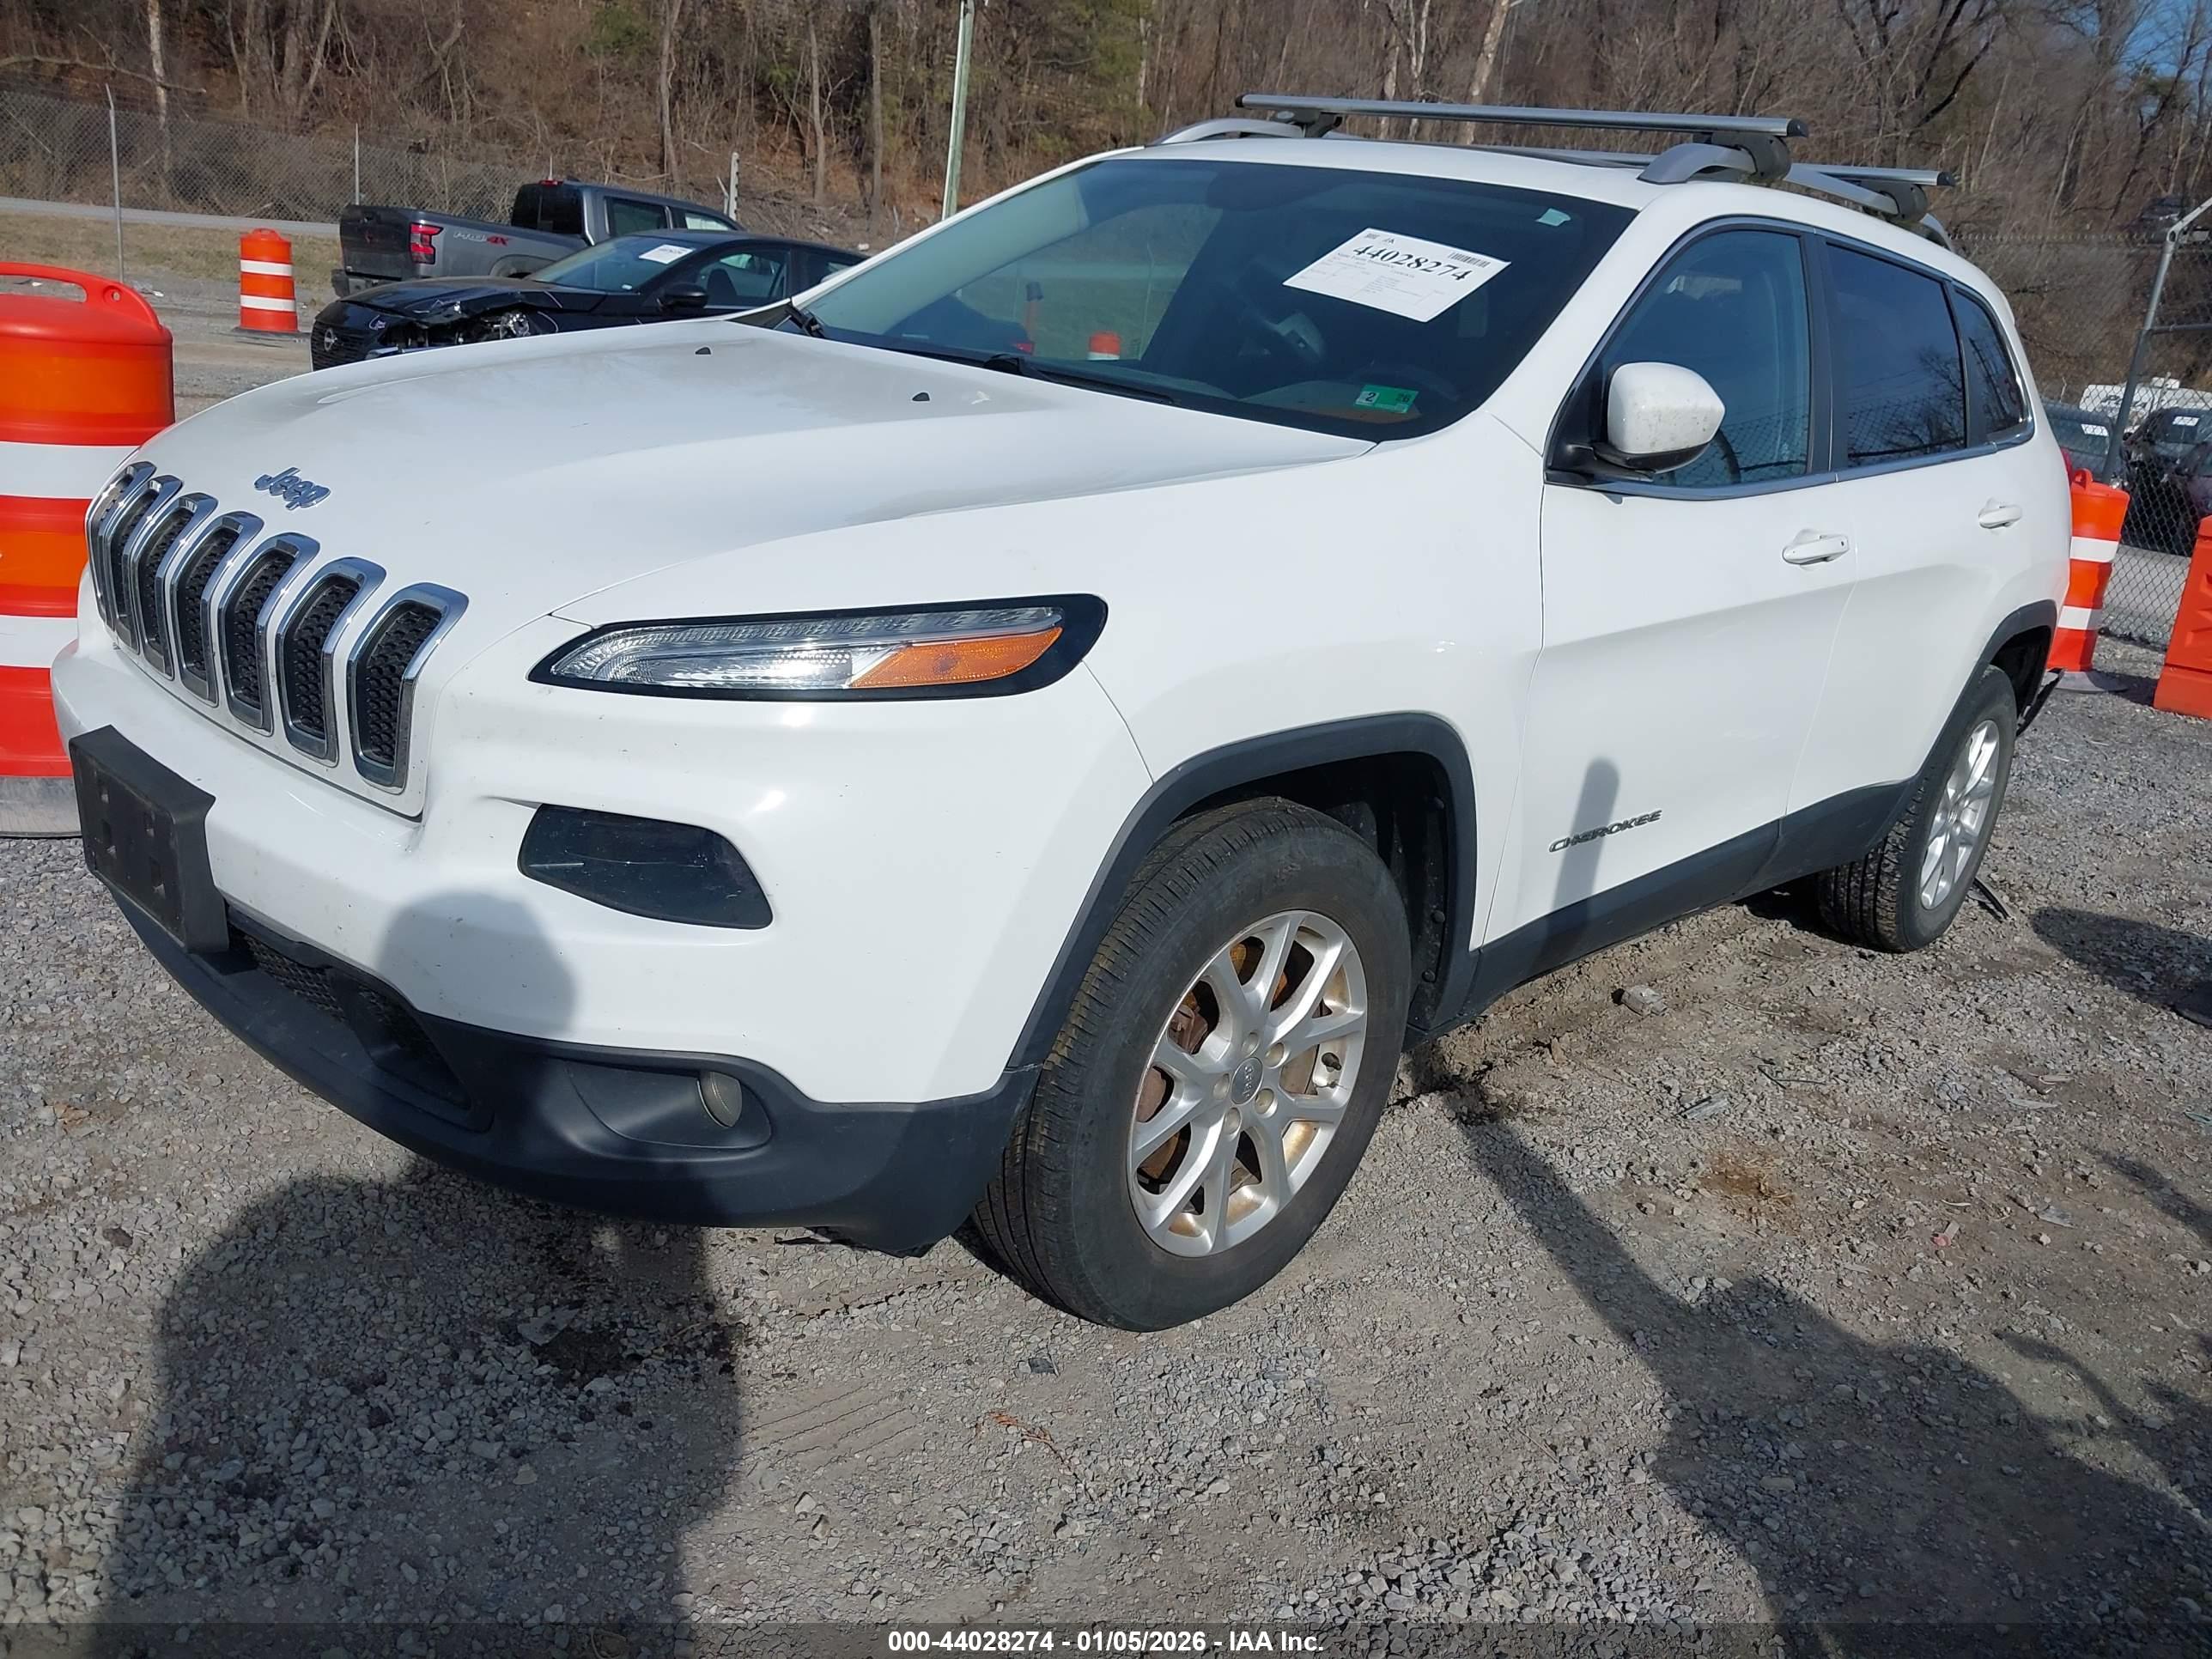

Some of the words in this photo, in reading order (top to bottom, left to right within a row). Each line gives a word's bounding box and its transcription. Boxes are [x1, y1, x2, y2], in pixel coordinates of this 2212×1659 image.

[1353, 245, 1473, 282] 44028274
[1364, 392, 1376, 403] 2
[254, 466, 331, 511] Jeep
[1549, 810, 1662, 853] CHEROKEE
